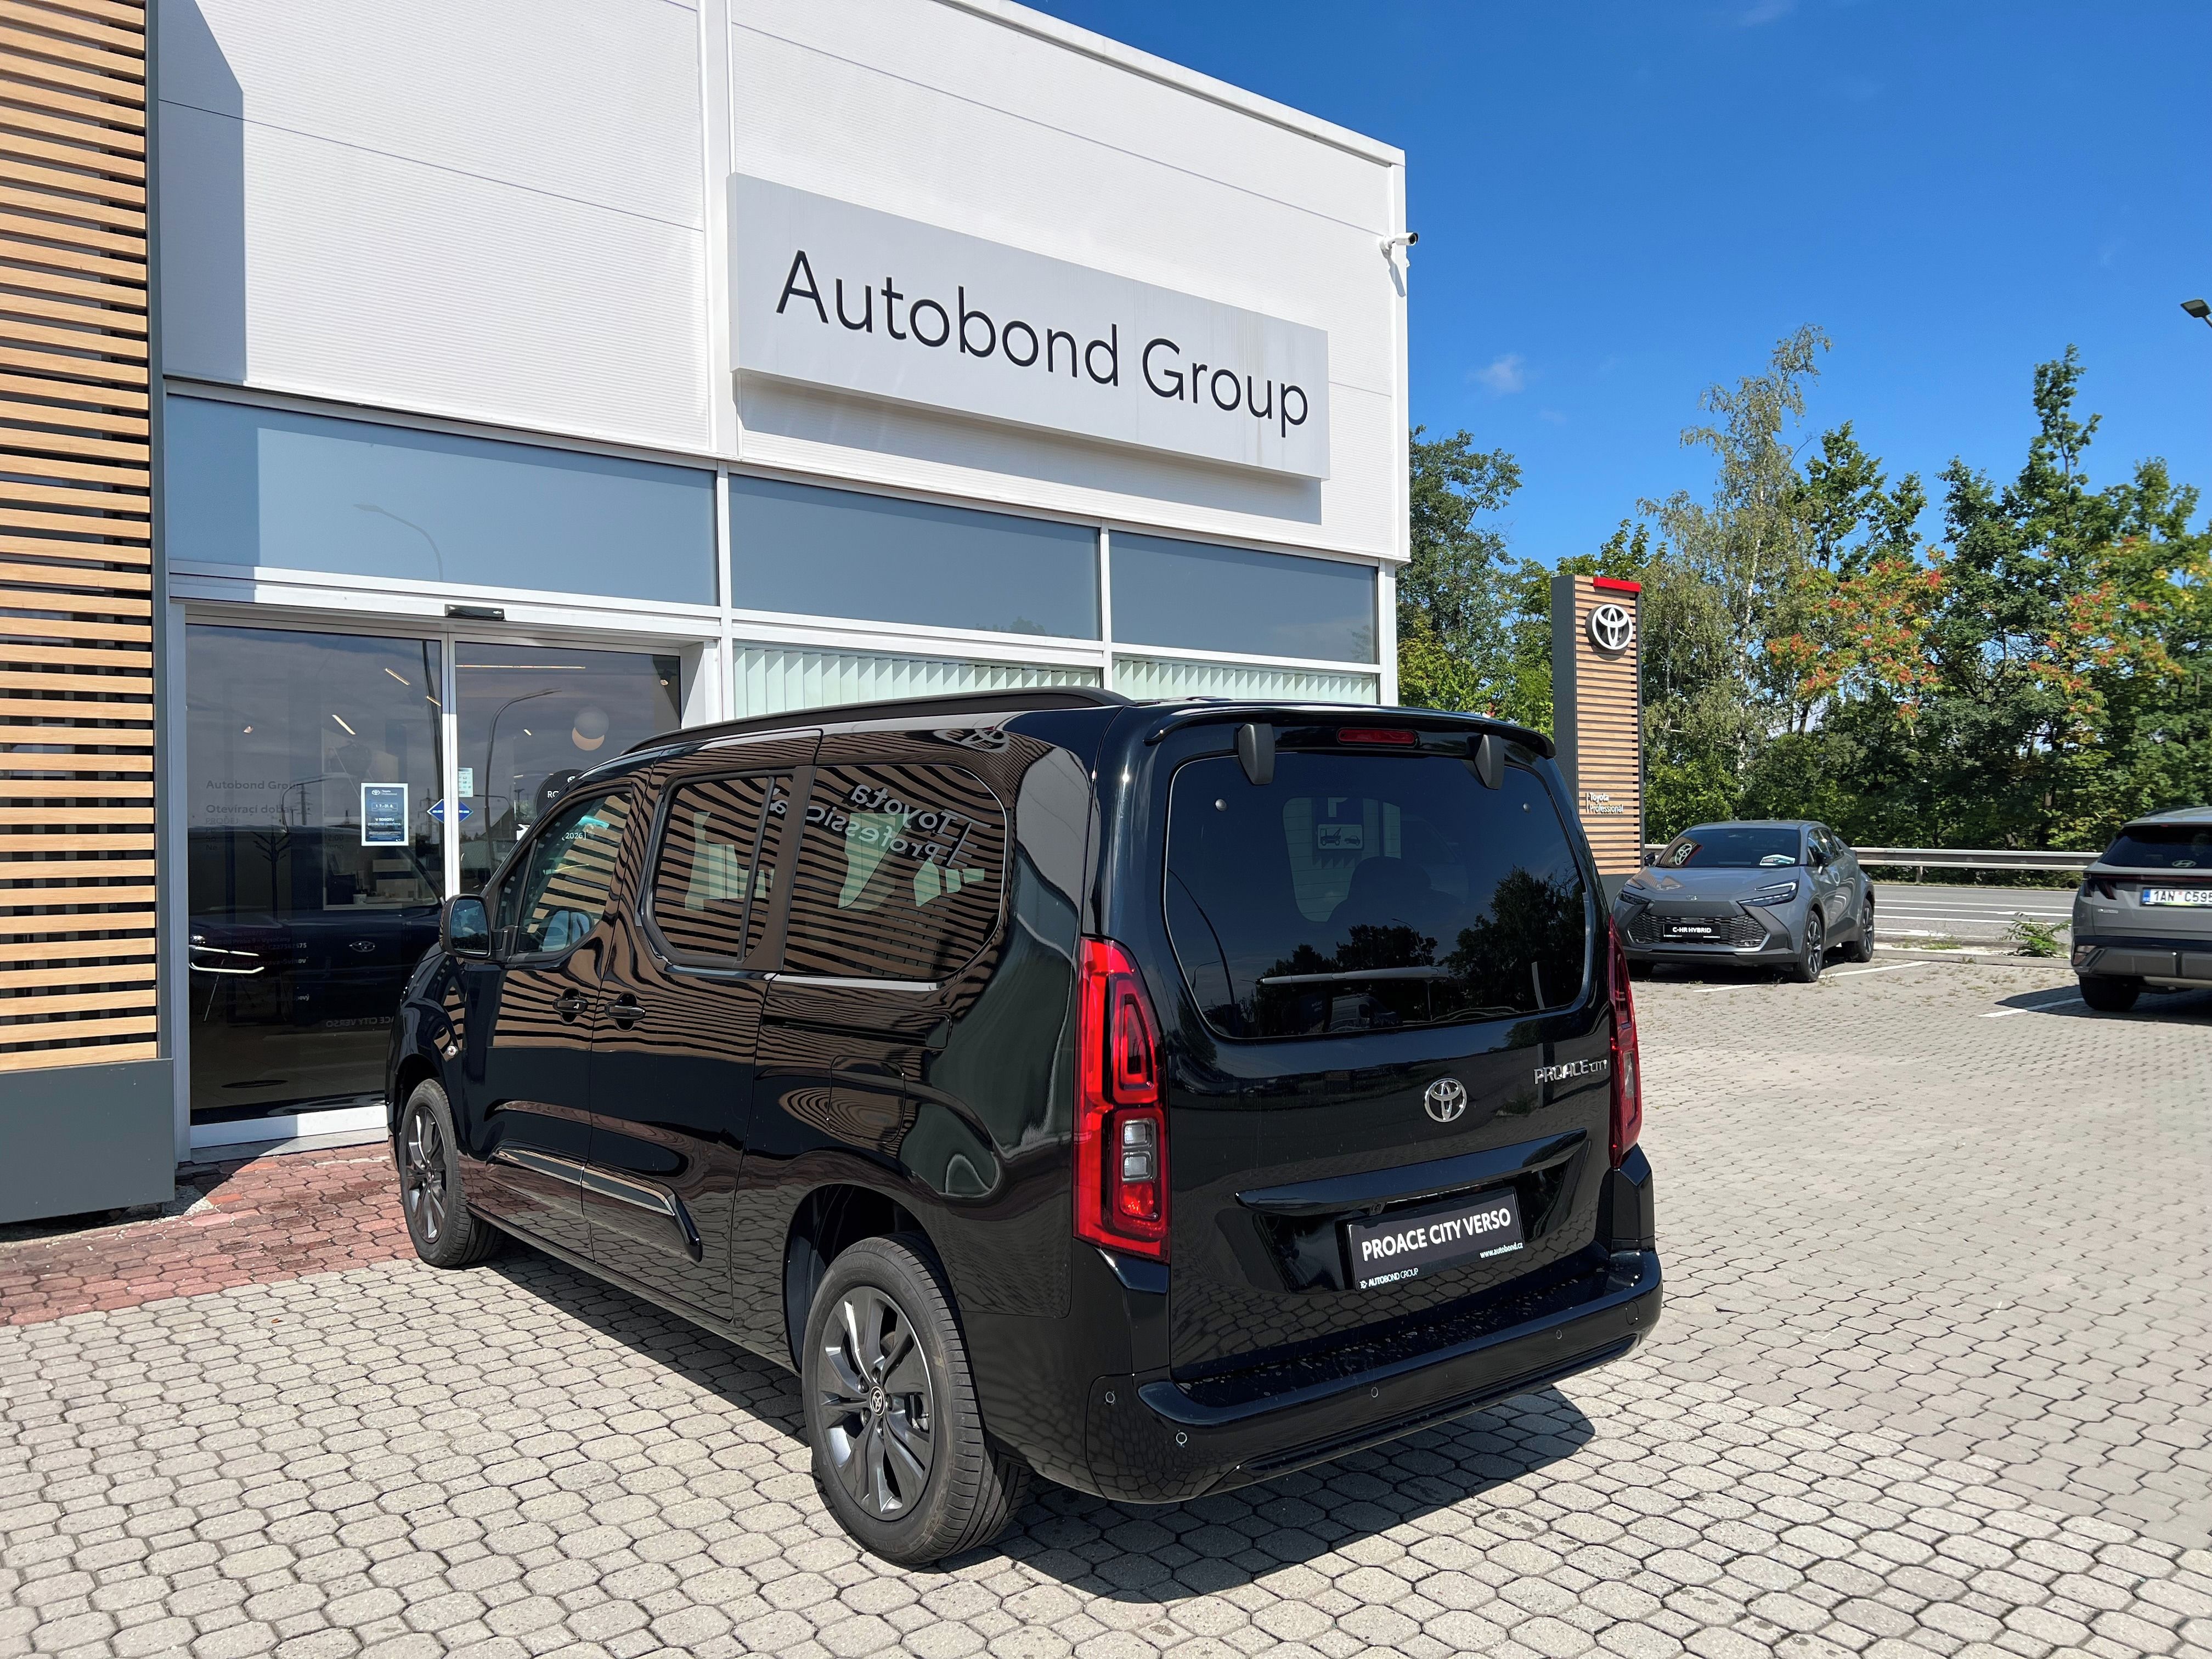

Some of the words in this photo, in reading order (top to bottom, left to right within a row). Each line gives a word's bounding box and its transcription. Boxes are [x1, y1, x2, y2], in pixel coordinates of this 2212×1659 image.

[776, 250, 1118, 387] Autobond
[1142, 337, 1308, 438] Group
[206, 780, 264, 789] Autobond
[1589, 792, 1609, 803] Toyota
[1589, 803, 1624, 812] Professional
[2154, 890, 2175, 901] 1AN
[1533, 1059, 1589, 1085] PROACE
[1589, 1059, 1607, 1073] CITY
[1361, 1228, 1428, 1262] PROACE
[1429, 1220, 1462, 1245] CITY
[1462, 1208, 1511, 1236] VERSO
[1480, 1242, 1523, 1259] www.autobond.cz
[1368, 1272, 1400, 1287] AUTOBOND
[1400, 1267, 1419, 1279] GROUP
